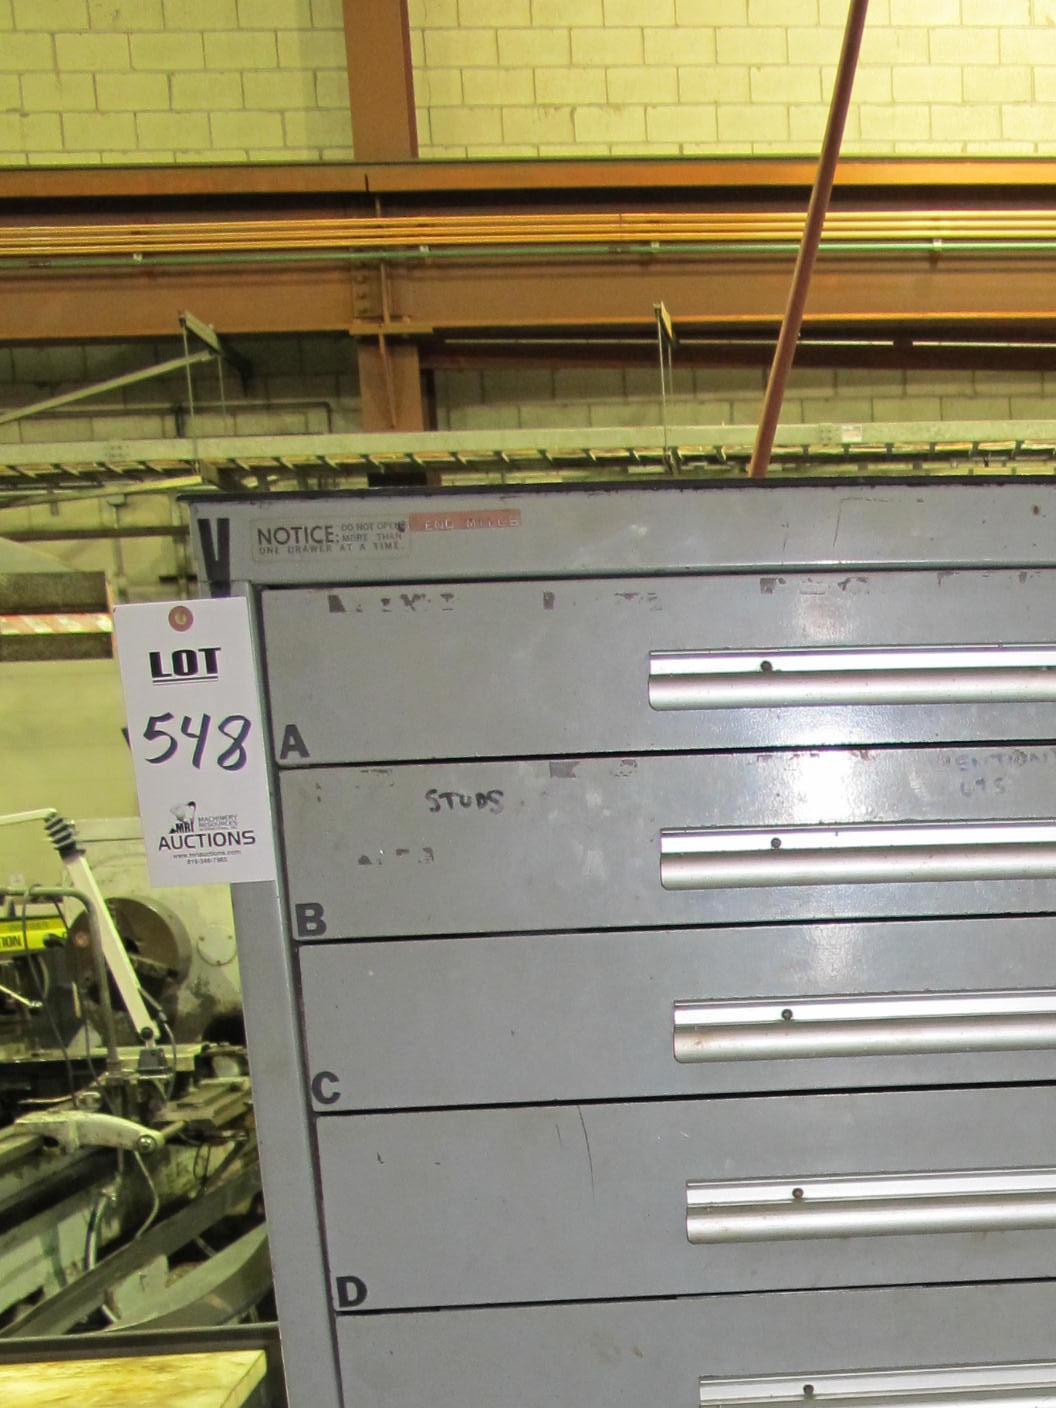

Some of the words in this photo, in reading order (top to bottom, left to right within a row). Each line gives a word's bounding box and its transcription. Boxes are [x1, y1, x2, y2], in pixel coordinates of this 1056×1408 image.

[257, 525, 340, 545] NOTICE:
[341, 523, 354, 532] DO
[356, 522, 374, 531] NOT
[377, 531, 402, 541] THAN
[259, 546, 279, 555] ONE
[288, 545, 332, 554] DRAWER
[340, 543, 353, 552] AT
[359, 543, 367, 551] A
[148, 647, 221, 678] LOT
[142, 711, 252, 772] 548
[280, 724, 309, 760] A
[425, 788, 504, 815] STUDS
[158, 829, 256, 851] AUCTIONS
[295, 901, 327, 937] B
[311, 1070, 342, 1105] C
[335, 1275, 368, 1308] D
